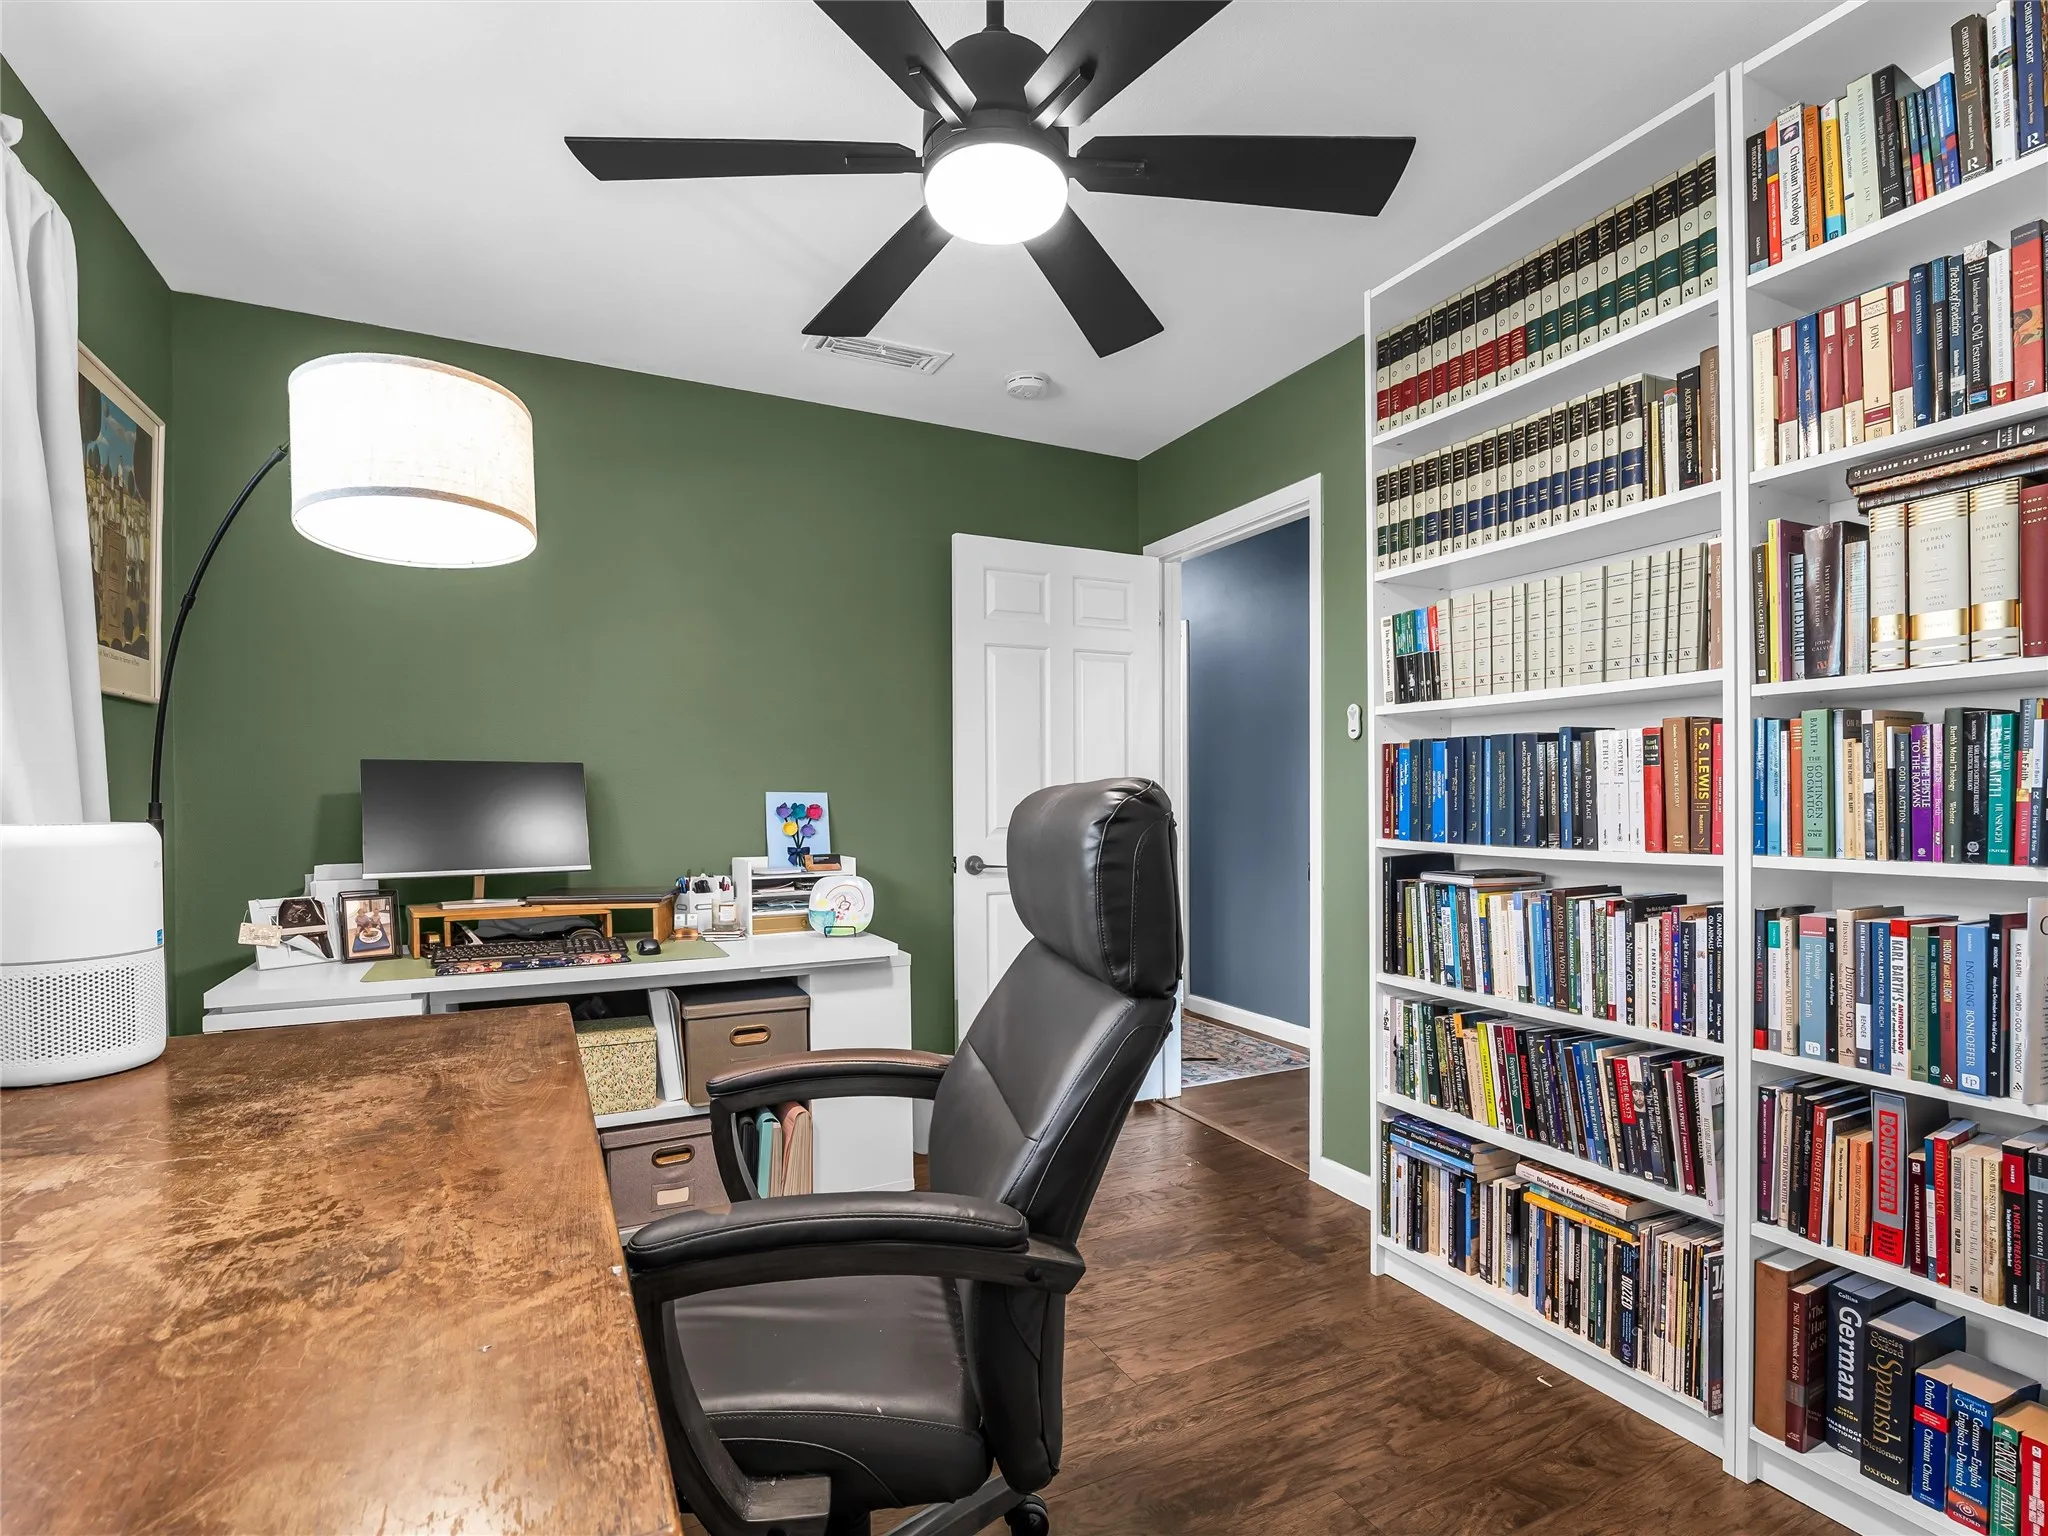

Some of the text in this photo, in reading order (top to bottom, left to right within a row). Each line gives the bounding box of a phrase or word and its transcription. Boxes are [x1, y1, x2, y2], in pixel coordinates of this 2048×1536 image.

[2024, 2, 2034, 64] CHRISTIAN THOUGHT
[1961, 27, 1972, 86] CHRISTIAN THOUGHT
[1790, 146, 1801, 225] Christian Theology
[1826, 162, 1834, 189] Theology
[1951, 266, 1959, 278] The
[1950, 279, 1960, 295] Book
[1971, 278, 1981, 315] Understanding
[1951, 302, 1960, 336] Revelation
[1972, 324, 1983, 340] Old
[1869, 325, 1879, 350] JOHN
[1972, 341, 1983, 382] Testament
[1685, 428, 1692, 437] OF
[1863, 444, 1971, 476] KINGDOM NEW TESTAMENT
[1920, 533, 1952, 544] HEBREW
[1975, 521, 2010, 532] HEBREW
[1981, 532, 2001, 540] BIBLE
[1794, 562, 1804, 662] THE NEW TESTAMENT
[1912, 740, 1920, 752] TO
[1699, 728, 1709, 799] C. S. LEWIS
[1899, 784, 1905, 792] IN
[1912, 772, 1920, 807] ROMANS
[1921, 761, 1930, 807] THE EPISTLE
[1948, 765, 1956, 792] Theology
[1708, 916, 1714, 925] ON
[1717, 913, 1722, 921] ON
[1559, 931, 1564, 939] IN
[1814, 944, 1822, 979] Citizenship
[1891, 940, 1903, 1001] KARL BARTH'S
[1842, 967, 1855, 1038] Disruptive Grace
[1966, 960, 1975, 1067] ENGAGING BONHOEFFER
[1509, 1057, 1519, 1098] Ecopsychology
[1624, 1094, 1632, 1119] BEASTS
[1814, 1137, 1822, 1192] BONHOEFFER
[1881, 1115, 1897, 1210] BONHOEFFER
[1536, 1176, 1559, 1190] Disciples
[1566, 1189, 1586, 1201] Friends
[1935, 1151, 1945, 1216] HIDING PLACE
[1621, 1275, 1632, 1310] BUZZED
[1838, 1292, 1859, 1303] Collins
[1792, 1326, 1800, 1358] Handbook
[1837, 1307, 1862, 1401] German
[1871, 1340, 1904, 1358] Oxford
[1872, 1331, 1904, 1349] Concise
[1791, 1365, 1799, 1380] Style
[1868, 1355, 1903, 1443] Spanish
[1924, 1380, 1936, 1409] Oxford
[1955, 1399, 1987, 1417] Oxford
[1862, 1440, 1904, 1464] Dictionary
[1922, 1429, 1934, 1491] Christian Church
[1865, 1465, 1900, 1484] OXFORD
[1994, 1442, 2015, 1532] OXFORD ITALIAN
[1953, 1486, 1983, 1505] Dictionary
[1953, 1511, 1981, 1527] OXFORD
